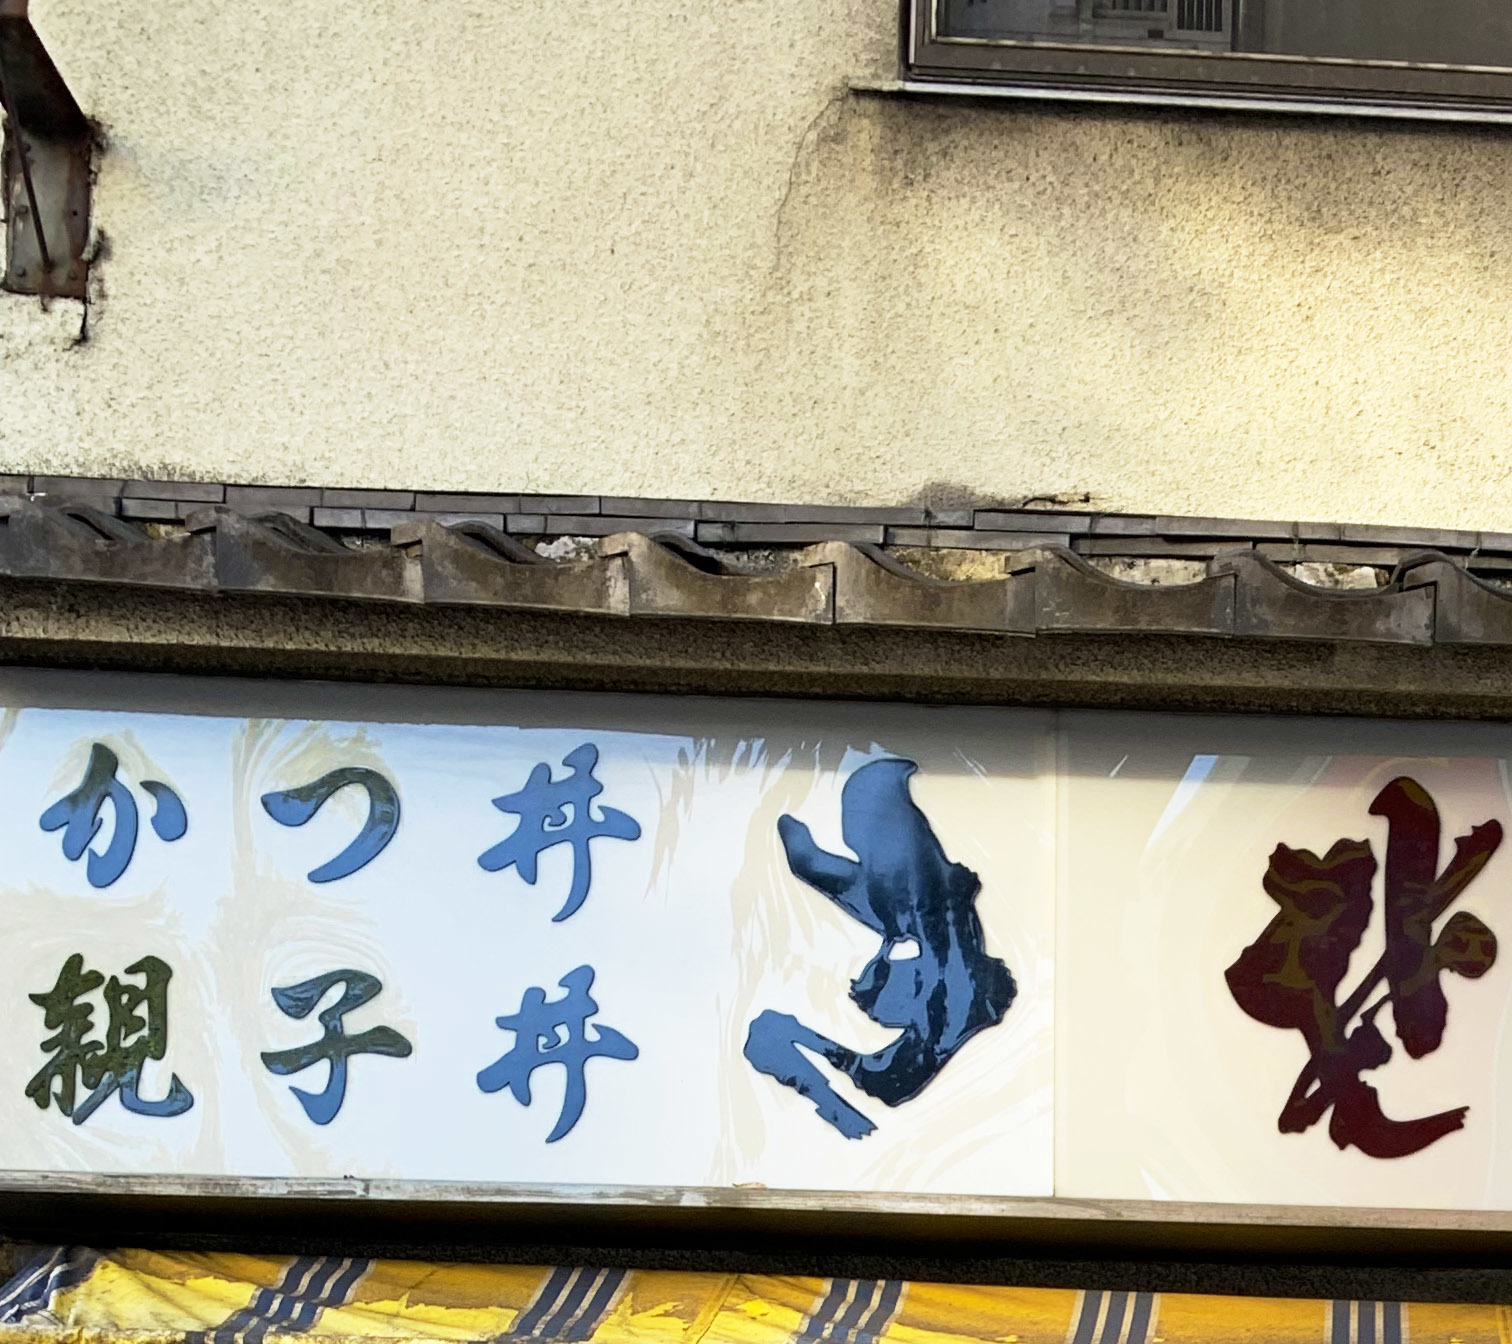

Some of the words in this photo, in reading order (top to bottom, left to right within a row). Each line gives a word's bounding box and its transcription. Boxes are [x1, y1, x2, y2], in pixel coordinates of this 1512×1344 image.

[38, 740, 644, 924] かつ丼
[25, 952, 641, 1145] 親子丼
